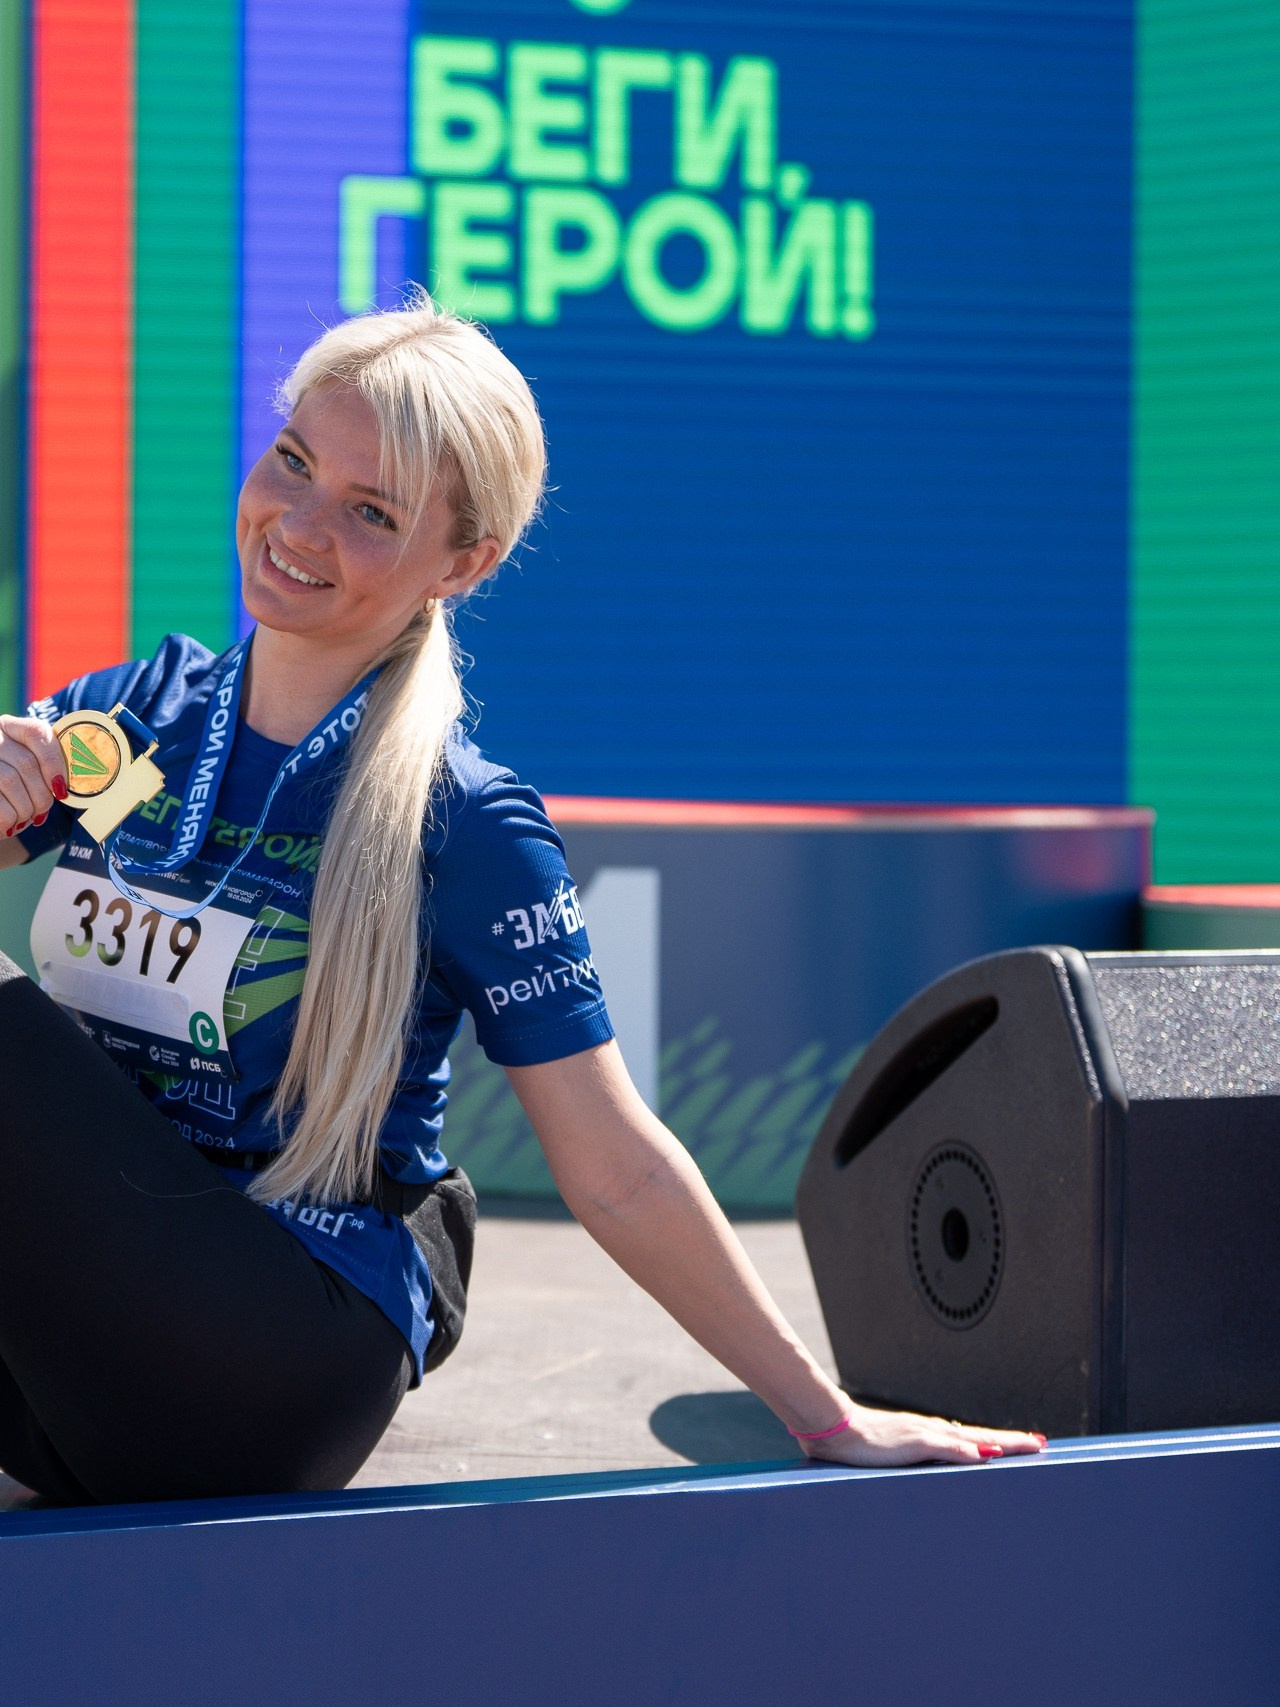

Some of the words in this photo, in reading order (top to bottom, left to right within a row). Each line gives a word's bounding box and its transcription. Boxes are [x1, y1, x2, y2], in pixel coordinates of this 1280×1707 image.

[413, 36, 809, 208] БЕГИ,
[308, 691, 369, 759] ЭТОТ
[65, 889, 201, 984] 3319
[201, 1061, 221, 1073] ПСБ
[195, 1130, 236, 1150] 2024
